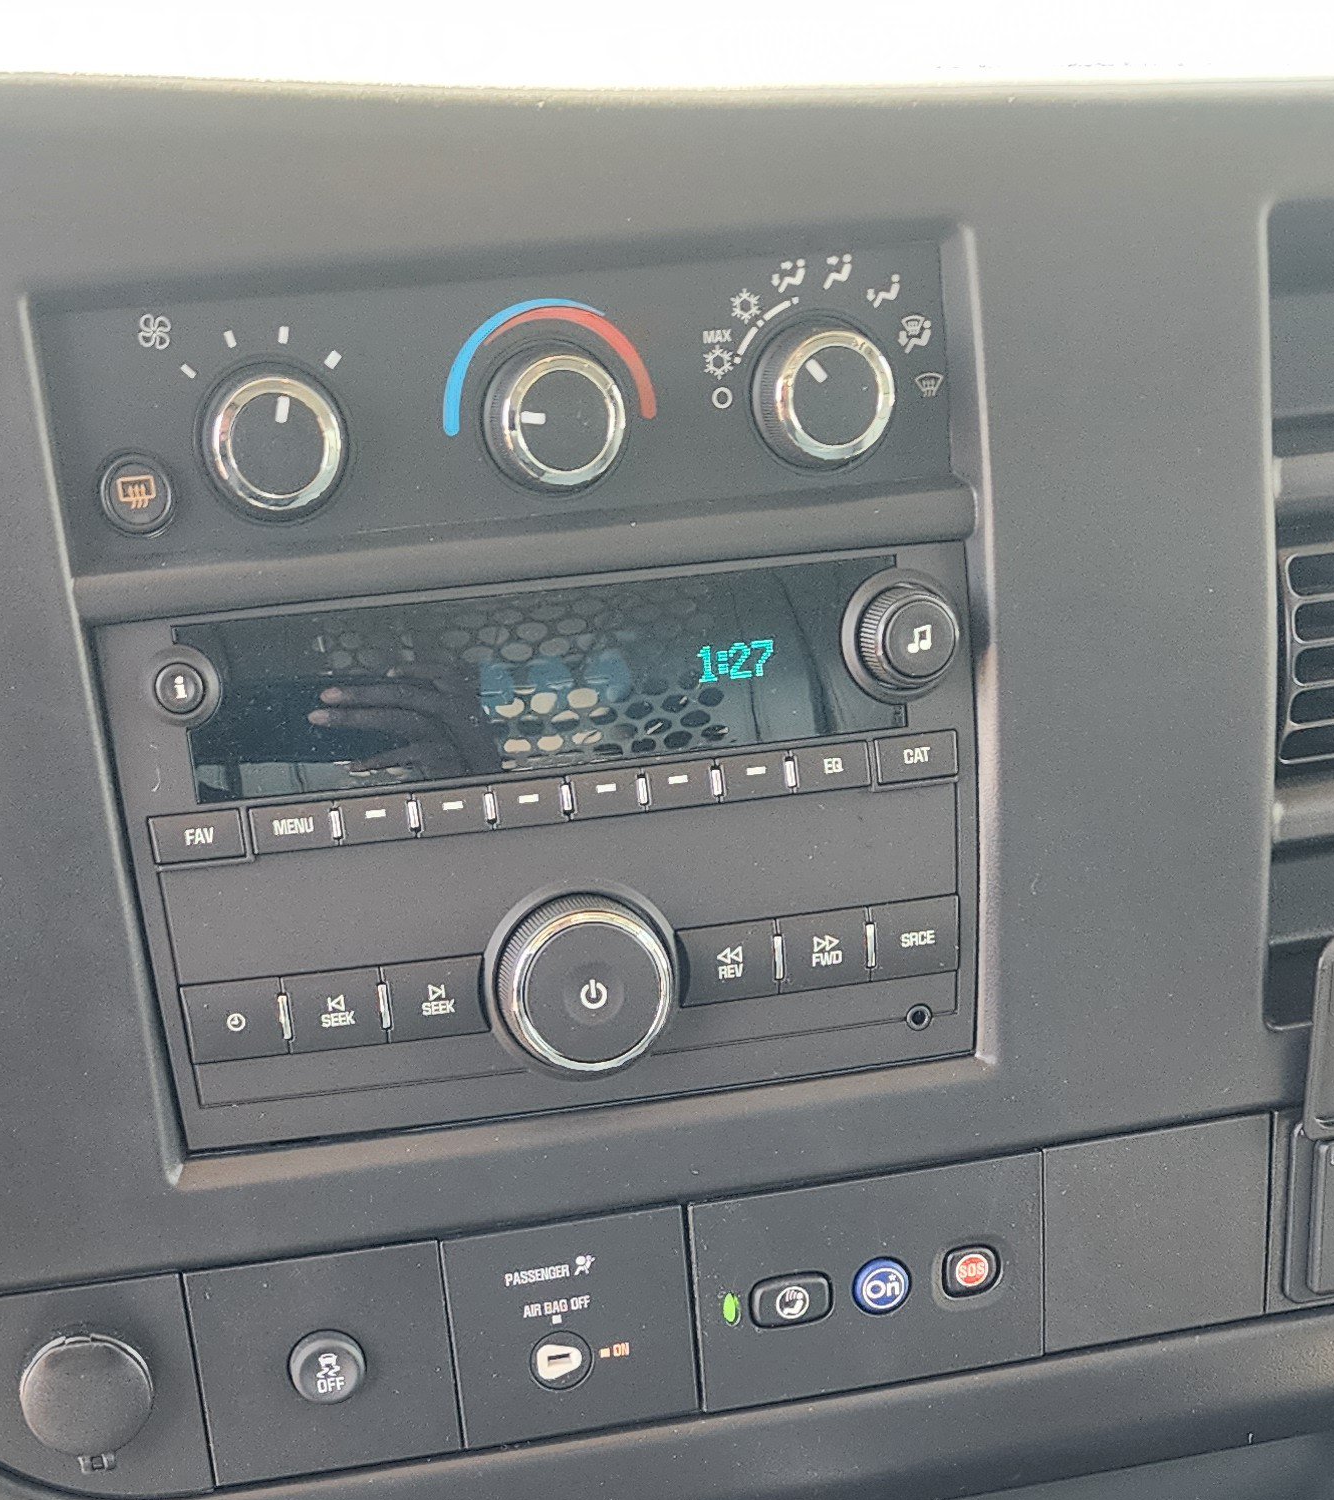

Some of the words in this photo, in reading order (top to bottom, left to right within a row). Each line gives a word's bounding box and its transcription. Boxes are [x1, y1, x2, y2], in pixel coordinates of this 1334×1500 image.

[703, 328, 732, 344] MAX
[696, 639, 774, 683] 1:27
[903, 747, 930, 764] CAT
[824, 757, 844, 774] EQ
[273, 817, 314, 836] MENU
[185, 827, 214, 846] FAV
[901, 930, 935, 948] SRCE
[812, 949, 843, 968] FWD
[718, 963, 744, 980] REV
[422, 999, 455, 1016] SEEK
[321, 1011, 356, 1028] SEEK
[504, 1264, 570, 1287] PASSENGER
[958, 1262, 985, 1278] SOS
[867, 1279, 900, 1299] On
[523, 1303, 542, 1318] AIR
[544, 1299, 568, 1315] BAG
[570, 1295, 591, 1311] OFF
[613, 1342, 630, 1357] ON
[316, 1376, 346, 1394] OFF
